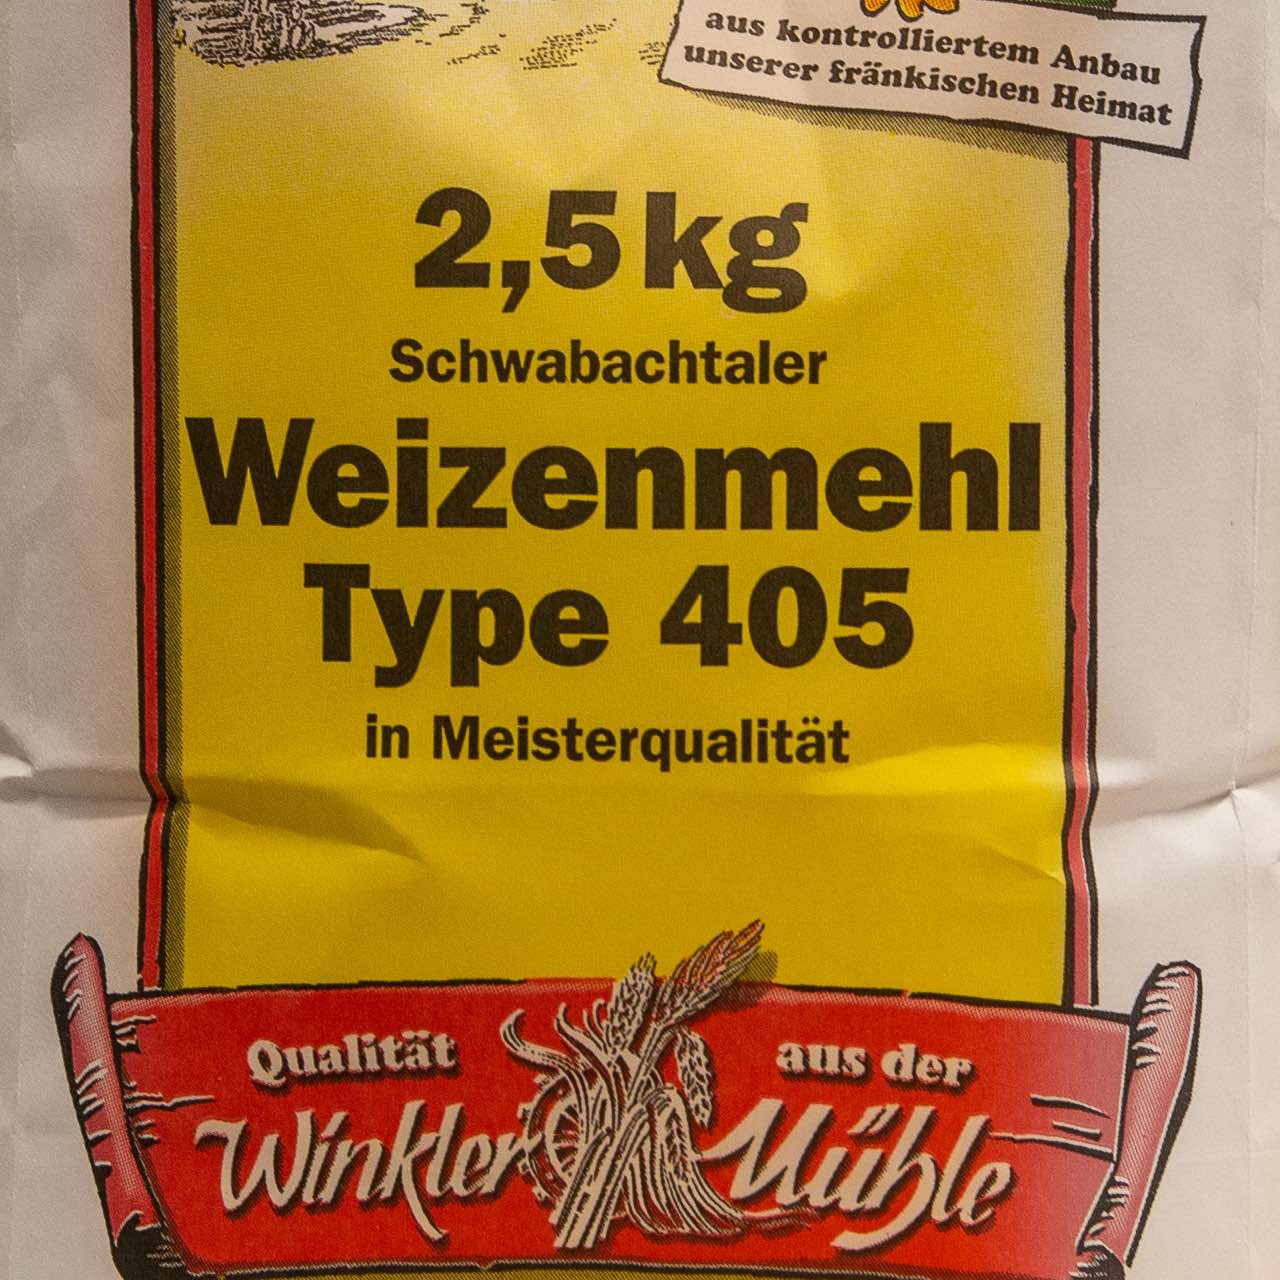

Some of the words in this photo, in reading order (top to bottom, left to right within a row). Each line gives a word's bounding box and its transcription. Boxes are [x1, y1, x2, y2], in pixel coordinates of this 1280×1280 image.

[683, 40, 819, 83] unserer
[828, 61, 1040, 106] fränkischen
[1052, 83, 1173, 127] Heimat
[705, 9, 765, 37] aus
[775, 19, 1040, 65] kontrolliertem
[1055, 44, 1161, 85] Anbau
[389, 338, 828, 385] Schwabachtaler
[184, 417, 1041, 532] Weizenmehl
[303, 562, 609, 689] Type
[660, 565, 914, 669] 405
[365, 714, 410, 760] in
[432, 714, 851, 773] Meisterqualität
[246, 1029, 460, 1090] Qualität
[775, 1041, 869, 1080] aus
[880, 1042, 976, 1090] der
[194, 1099, 526, 1242] Winkler
[700, 1097, 1014, 1252] Mühle
